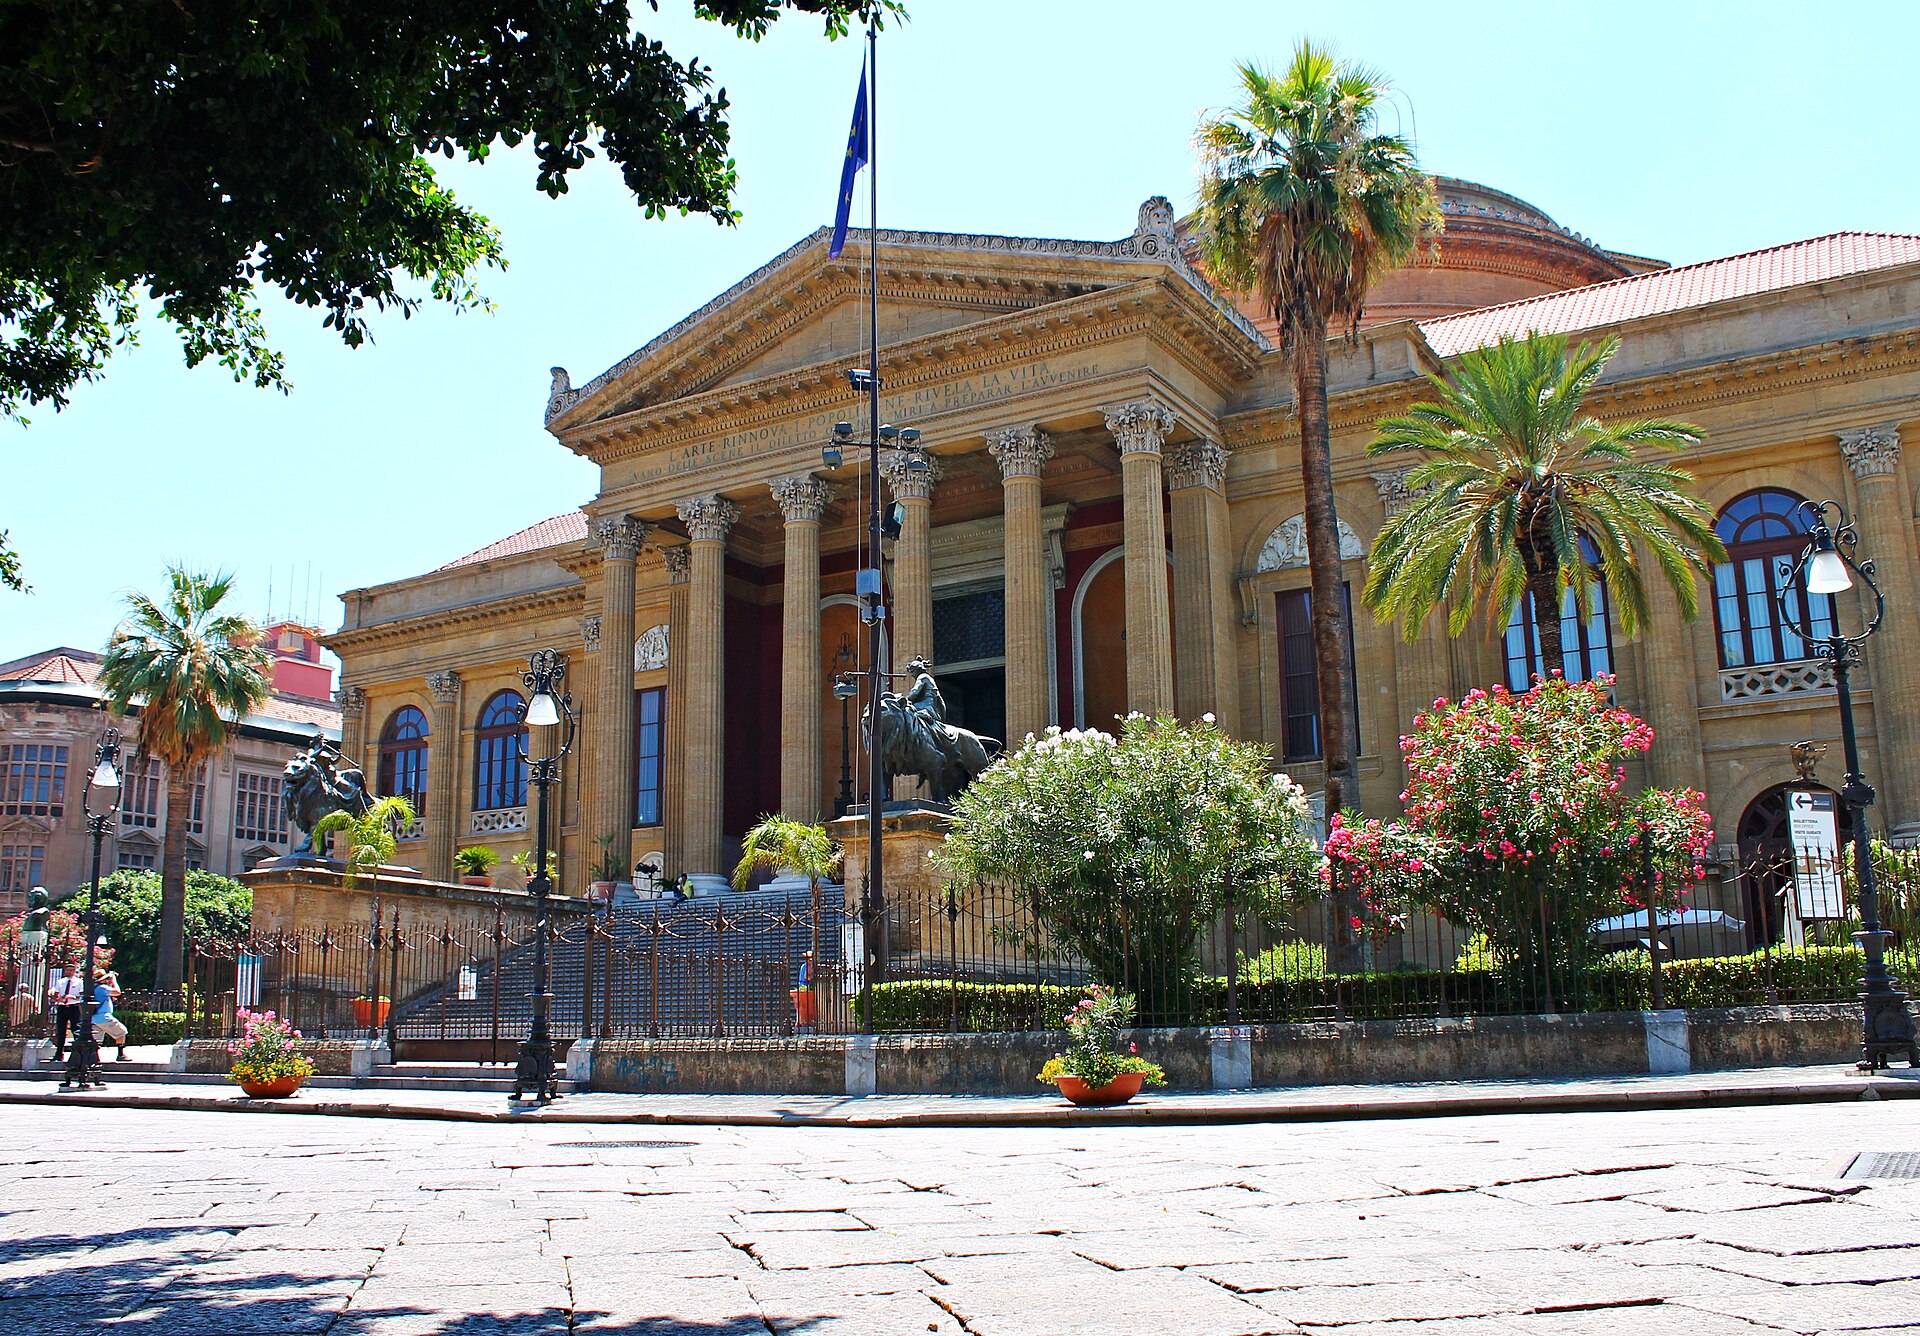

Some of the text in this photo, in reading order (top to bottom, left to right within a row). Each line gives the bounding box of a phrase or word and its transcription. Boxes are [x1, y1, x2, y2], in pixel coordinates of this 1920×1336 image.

[668, 457, 698, 474] DELLE
[705, 446, 744, 464] SCENE
[769, 429, 816, 449] DILETTO
[894, 404, 923, 421] MIRI
[945, 384, 1012, 409] PREPARAR
[723, 424, 788, 450] RINNOVA
[807, 405, 860, 430] POPOLI
[915, 380, 972, 404] RIVELA
[983, 373, 1001, 389] LA
[1010, 361, 1050, 381] VITA
